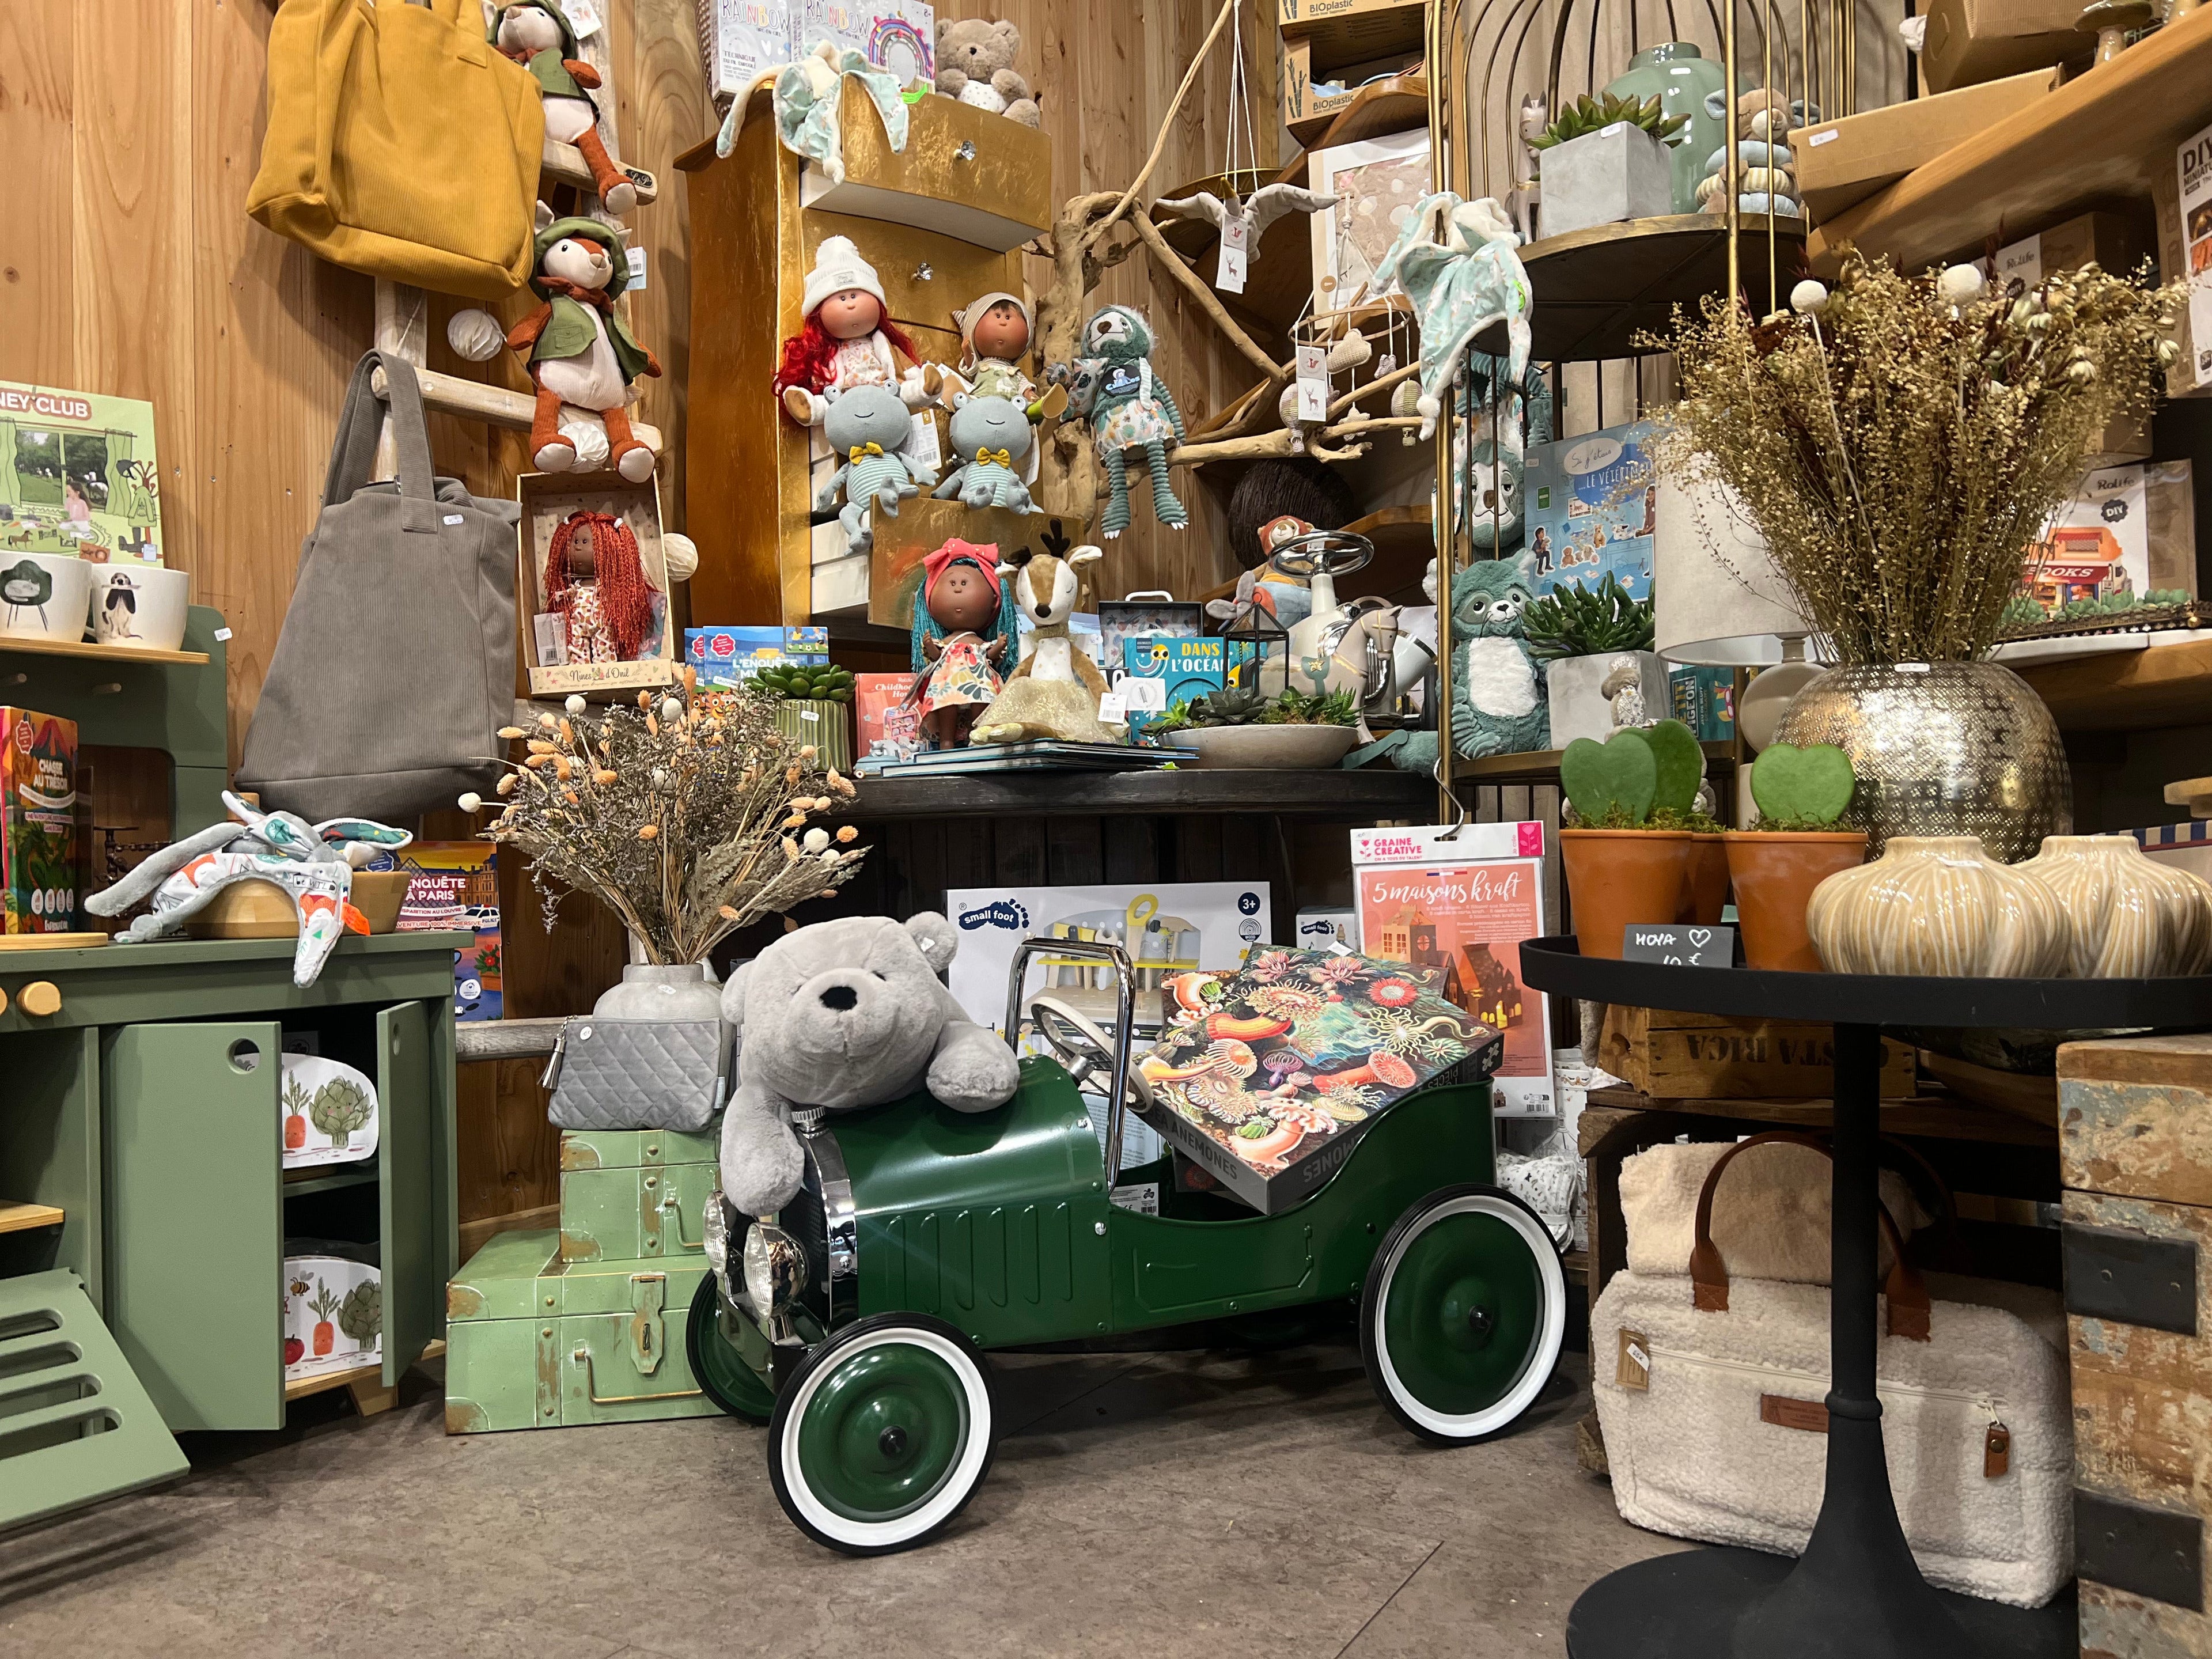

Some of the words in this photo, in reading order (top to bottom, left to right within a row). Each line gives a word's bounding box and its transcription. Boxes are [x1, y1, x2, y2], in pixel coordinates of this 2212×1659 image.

[1310, 0, 1354, 13] BIOplastic
[722, 0, 791, 32] RAINBOW
[806, 0, 870, 37] RAINBOW
[724, 51, 756, 62] TECHNIQUE
[1313, 94, 1354, 110] BIOplastic
[0, 391, 29, 410] EY
[36, 396, 89, 418] CLUB
[2097, 476, 2135, 490] Rolife
[2106, 505, 2124, 517] DIY
[1181, 643, 1220, 656] DANS
[570, 670, 592, 681] Nines
[605, 668, 630, 678] d'Onil
[1675, 684, 1686, 724] ETIT
[39, 759, 63, 777] CHASSE
[33, 775, 44, 787] AU
[1374, 837, 1412, 846] GRAINE
[1374, 845, 1422, 855] CREATIVE
[1373, 882, 1387, 903] 5
[1389, 883, 1468, 904] maisons
[1470, 870, 1522, 903] kraft
[406, 888, 415, 902] À
[419, 891, 455, 901] PARIS
[1243, 899, 1256, 910] 3+
[964, 910, 991, 923] small
[993, 910, 1014, 922] foot
[1635, 932, 1677, 946] HOYA
[1686, 1035, 1767, 1063] RICA
[1172, 1120, 1238, 1180] ANEMONES
